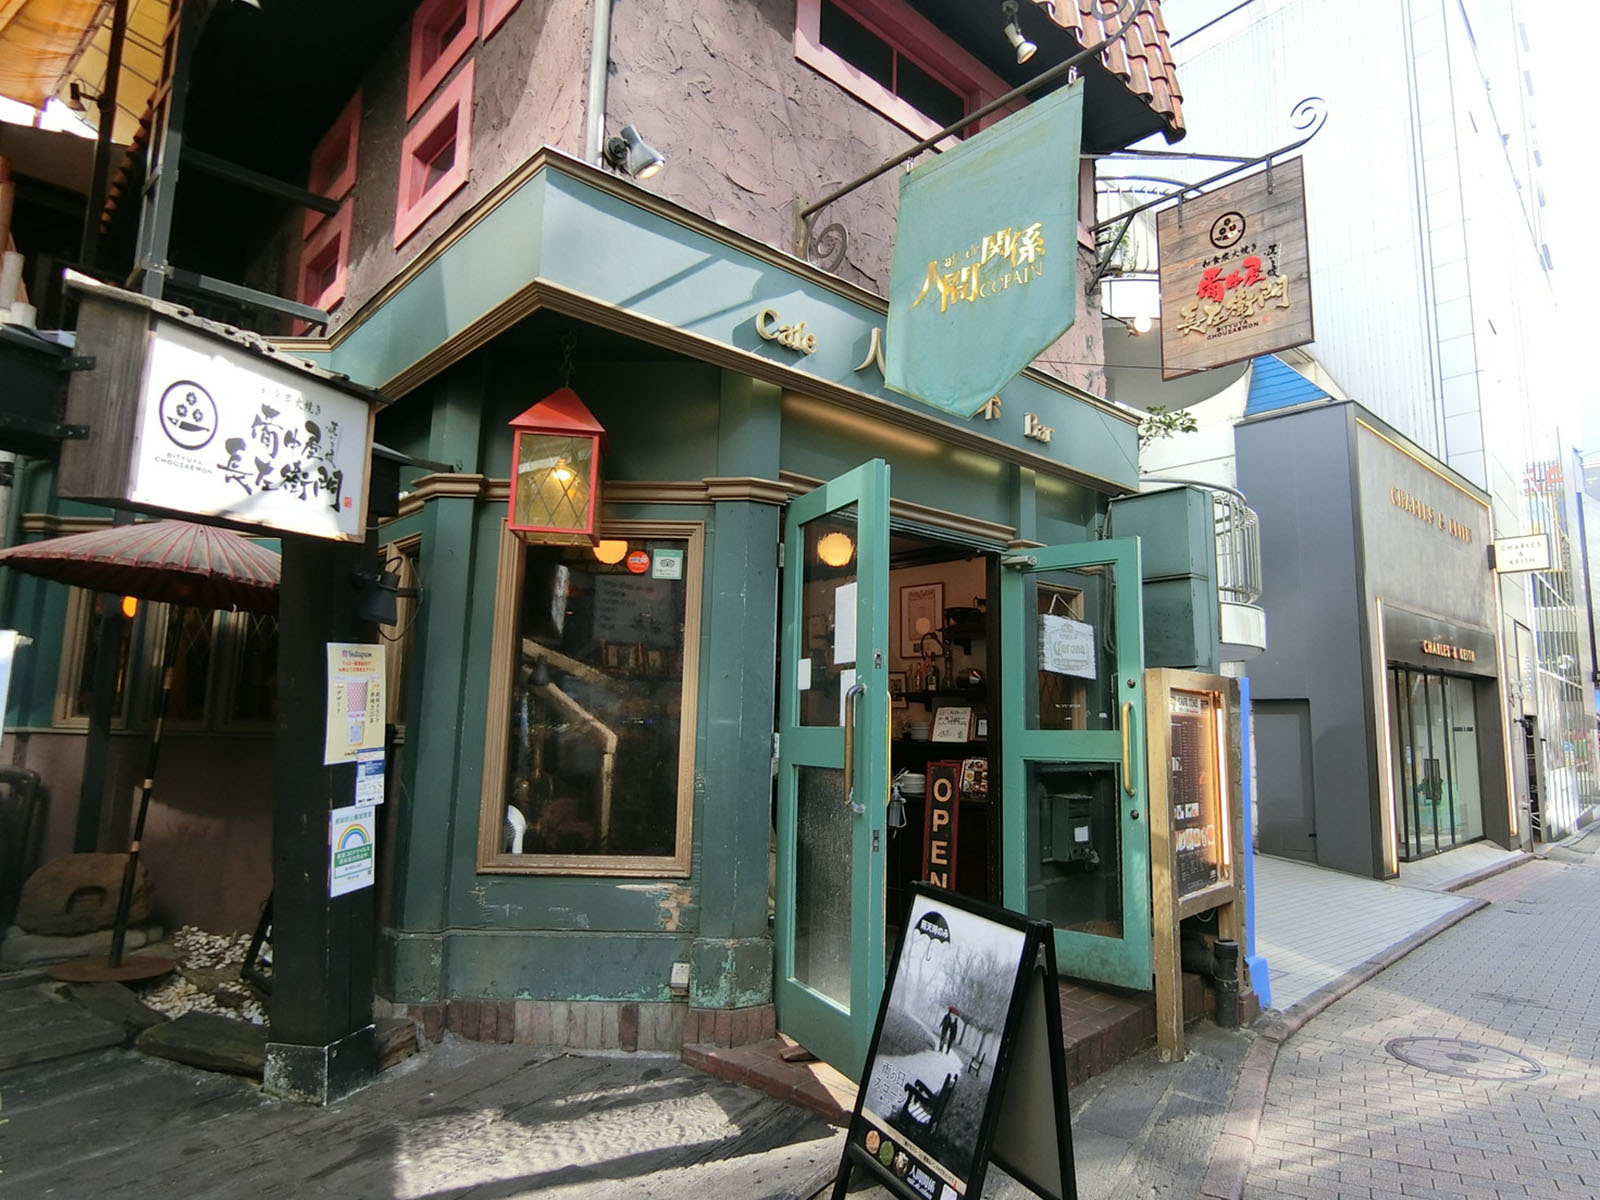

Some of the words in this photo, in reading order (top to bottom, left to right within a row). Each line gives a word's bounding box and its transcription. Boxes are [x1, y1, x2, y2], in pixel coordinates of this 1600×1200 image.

[909, 222, 1046, 313] 人間関係
[979, 261, 1043, 298] COPAIN
[1197, 256, 1267, 303] 備中屋
[1176, 274, 1291, 336] 長左衛門
[1206, 321, 1260, 341] CHOUZAEMON
[251, 403, 324, 461] 備中屋
[1024, 412, 1055, 442] Bar
[154, 456, 213, 475] CHOUZAEMON
[217, 437, 344, 513] 長左衛門
[1500, 541, 1541, 551] CHARLES
[1509, 557, 1536, 565] KEITH
[1053, 640, 1086, 658] Corona
[1423, 639, 1450, 658] CHARLES
[1459, 647, 1476, 662] KEITH
[929, 777, 953, 889] OPEN
[882, 1062, 906, 1087] 雨の日
[873, 1076, 907, 1104] スコーン
